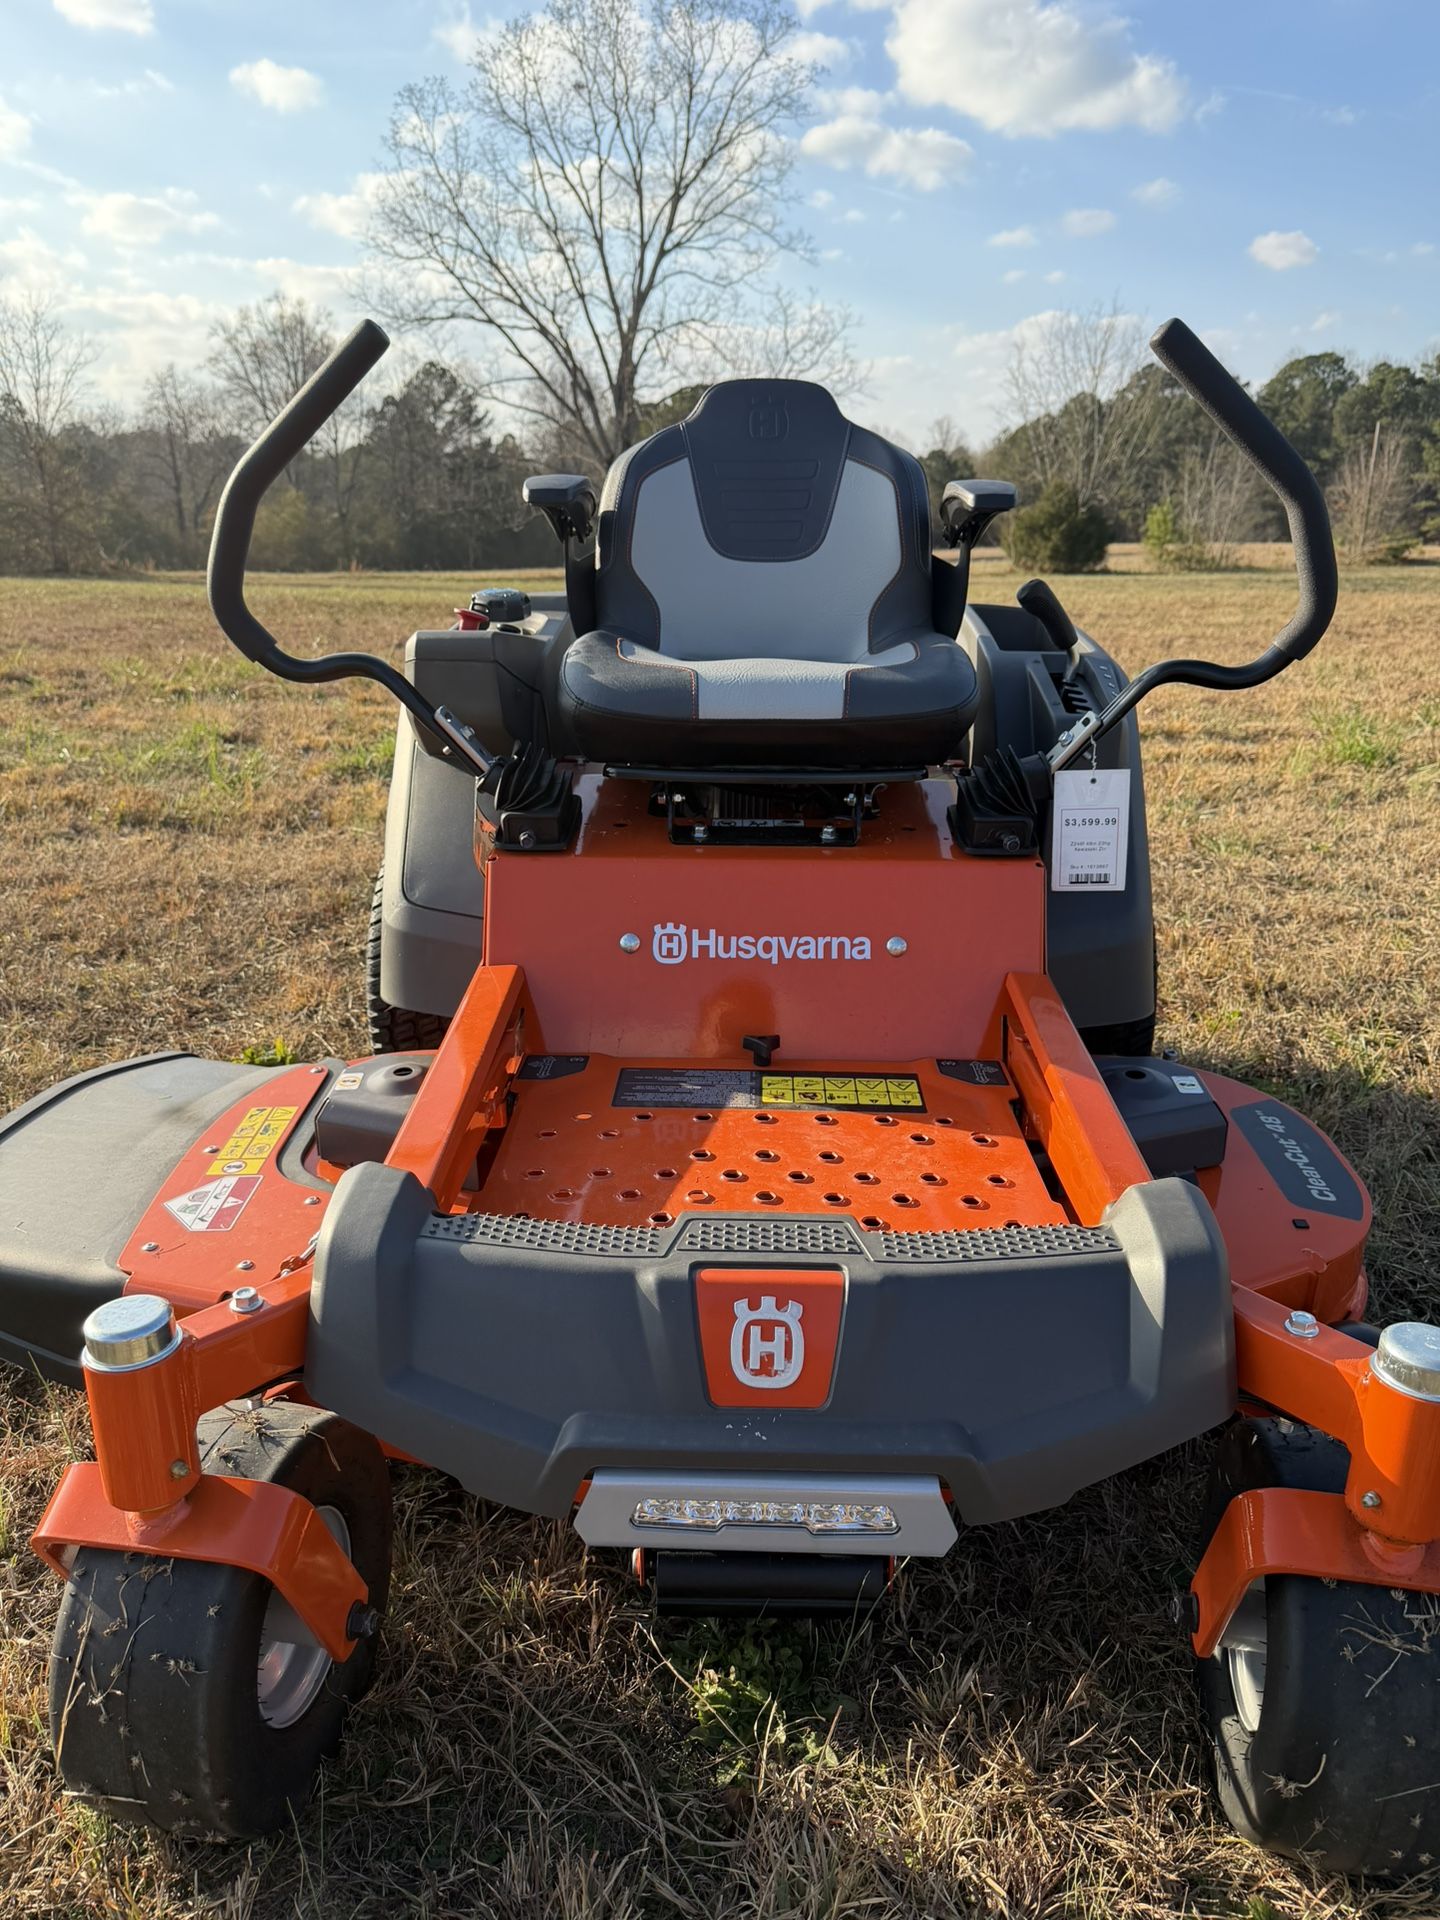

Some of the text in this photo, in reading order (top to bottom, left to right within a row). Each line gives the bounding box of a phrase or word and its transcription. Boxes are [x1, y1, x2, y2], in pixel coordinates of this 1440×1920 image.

[1064, 817, 1117, 827] $3,599.99
[691, 928, 871, 965] Husqvarna
[1255, 1109, 1337, 1202] ClearCut 48"
